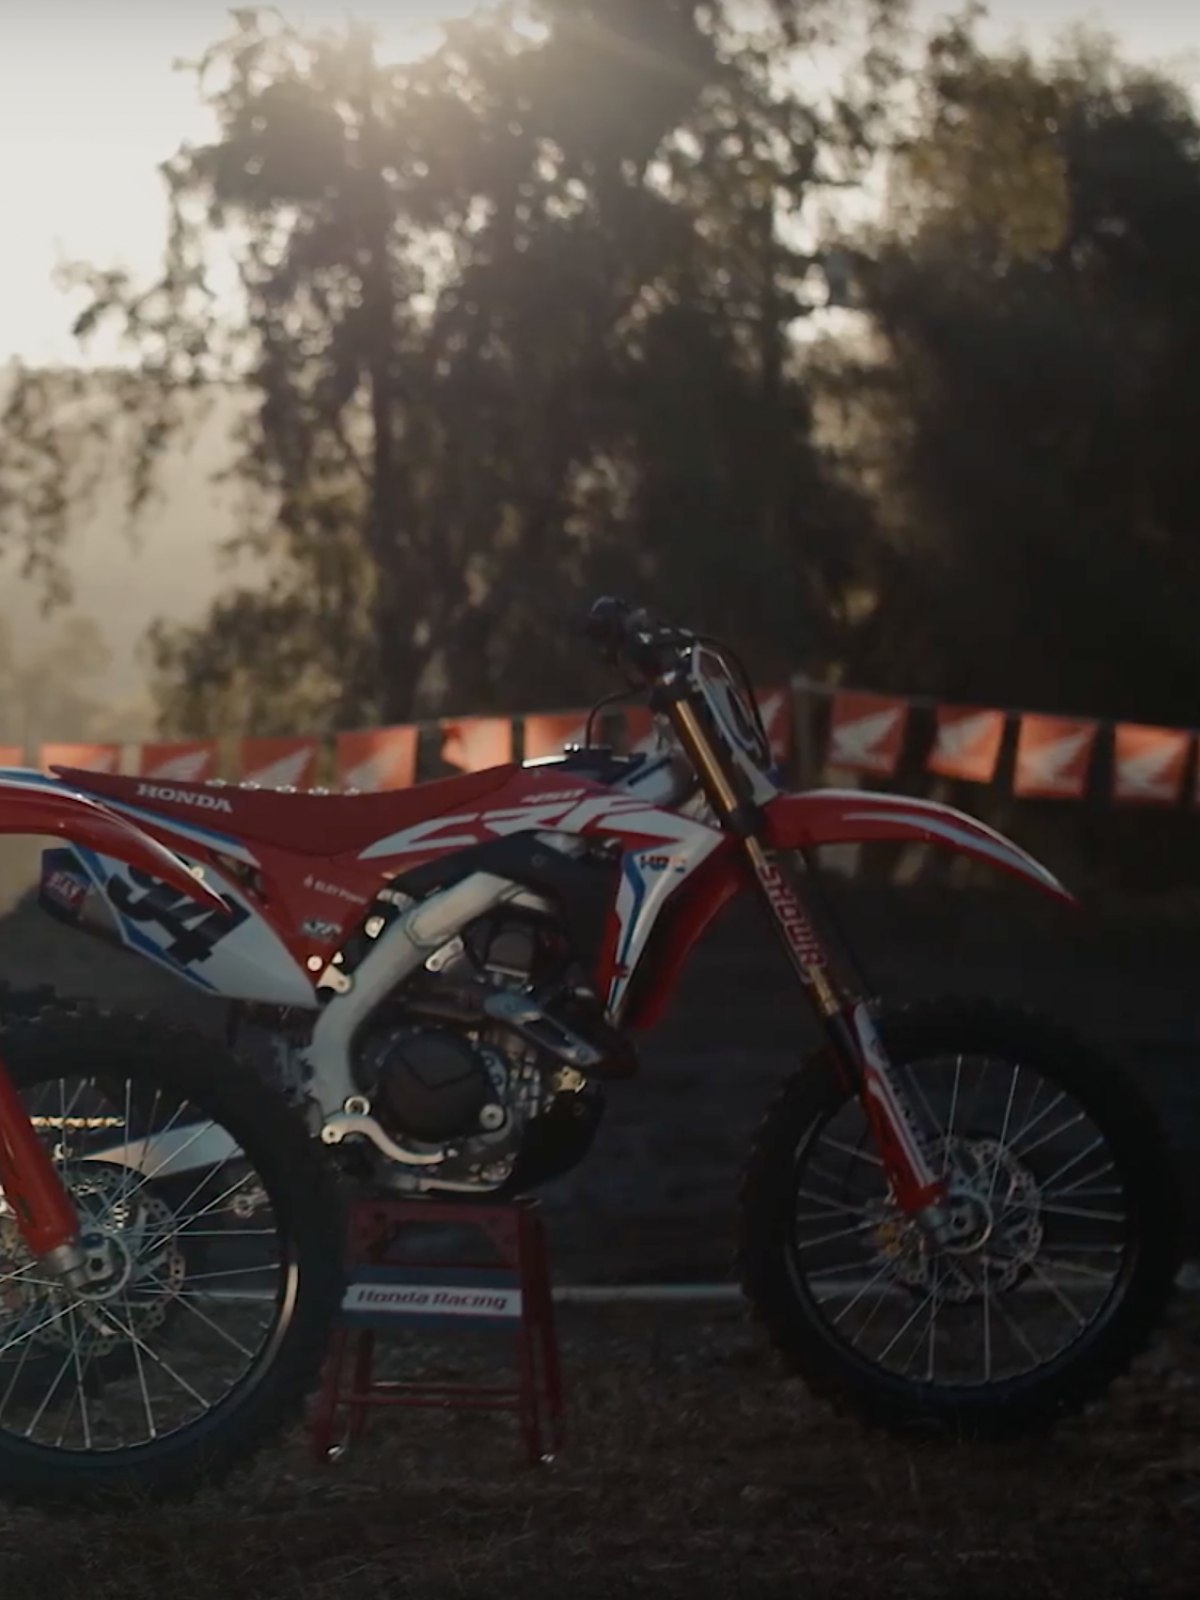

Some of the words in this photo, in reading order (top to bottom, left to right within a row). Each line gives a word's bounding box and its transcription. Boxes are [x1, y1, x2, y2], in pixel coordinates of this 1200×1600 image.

[135, 783, 234, 814] HONDA
[357, 1290, 430, 1305] Honda
[432, 1293, 508, 1310] Racing
